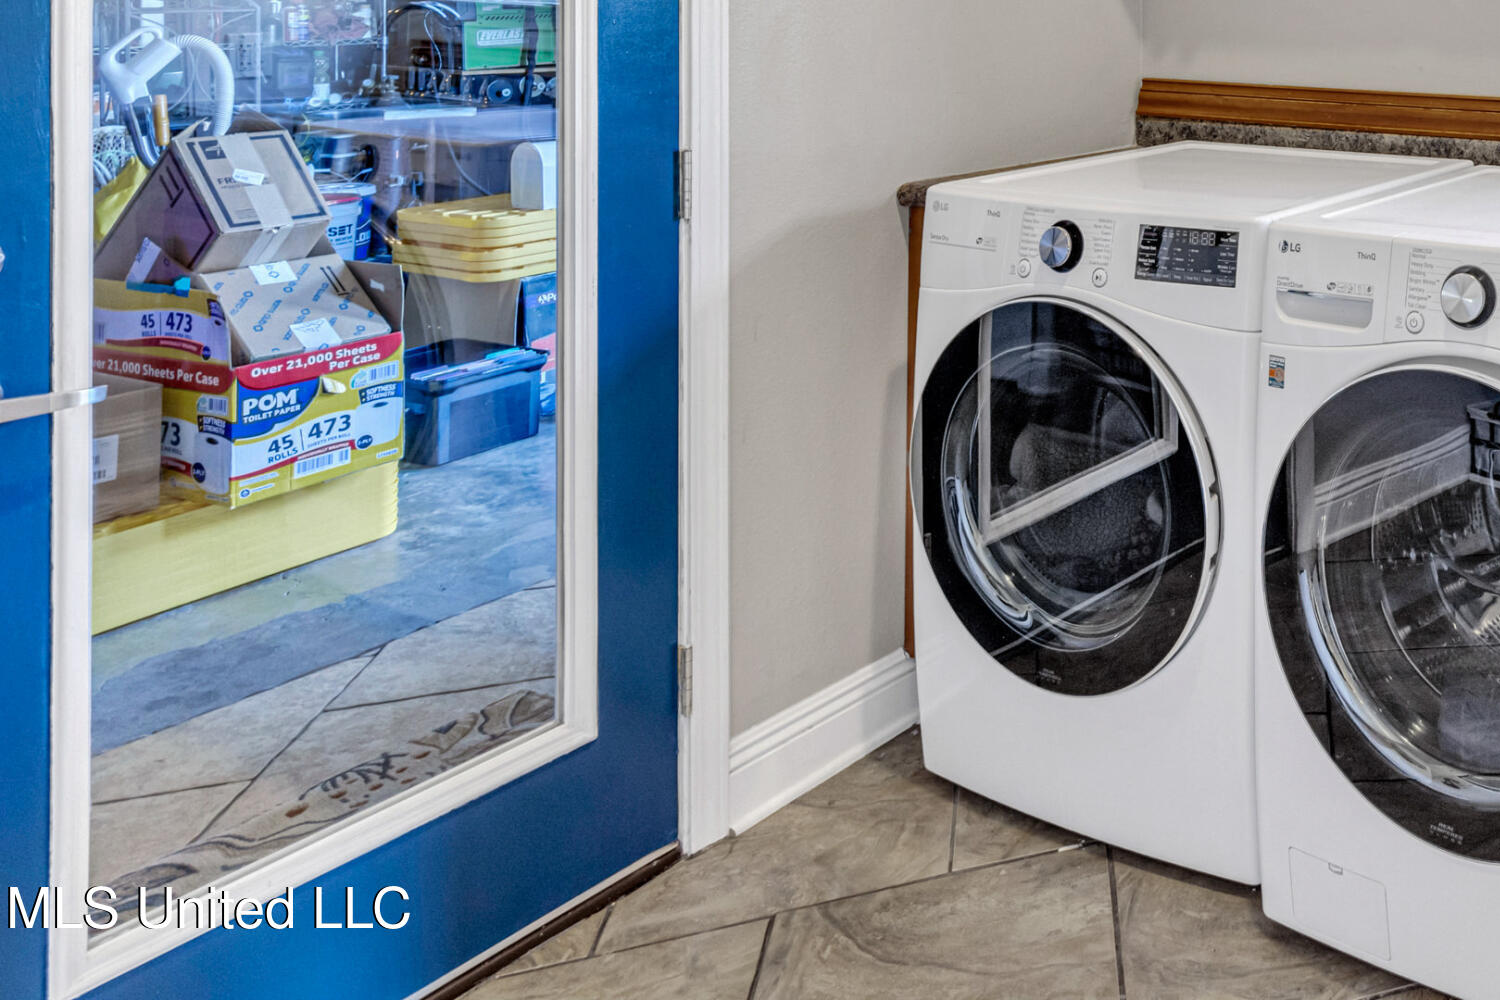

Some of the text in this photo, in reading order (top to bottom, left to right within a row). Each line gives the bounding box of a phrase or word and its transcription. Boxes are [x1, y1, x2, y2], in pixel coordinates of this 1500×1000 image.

[1357, 251, 1377, 261] ThinQ
[141, 311, 193, 334] 45 473
[251, 343, 377, 378] Over 21,000 Sheets
[329, 352, 381, 371] Per Case
[107, 359, 141, 376] 21,000
[142, 364, 175, 381] Sheets
[176, 369, 194, 383] Per
[195, 371, 220, 387] Case
[366, 383, 396, 394] SOFTNESS
[242, 389, 298, 417] POM
[242, 404, 301, 424] TOILET PAPER
[161, 420, 180, 447] 73
[267, 414, 351, 453] 45 473
[267, 447, 298, 463] ROLLS
